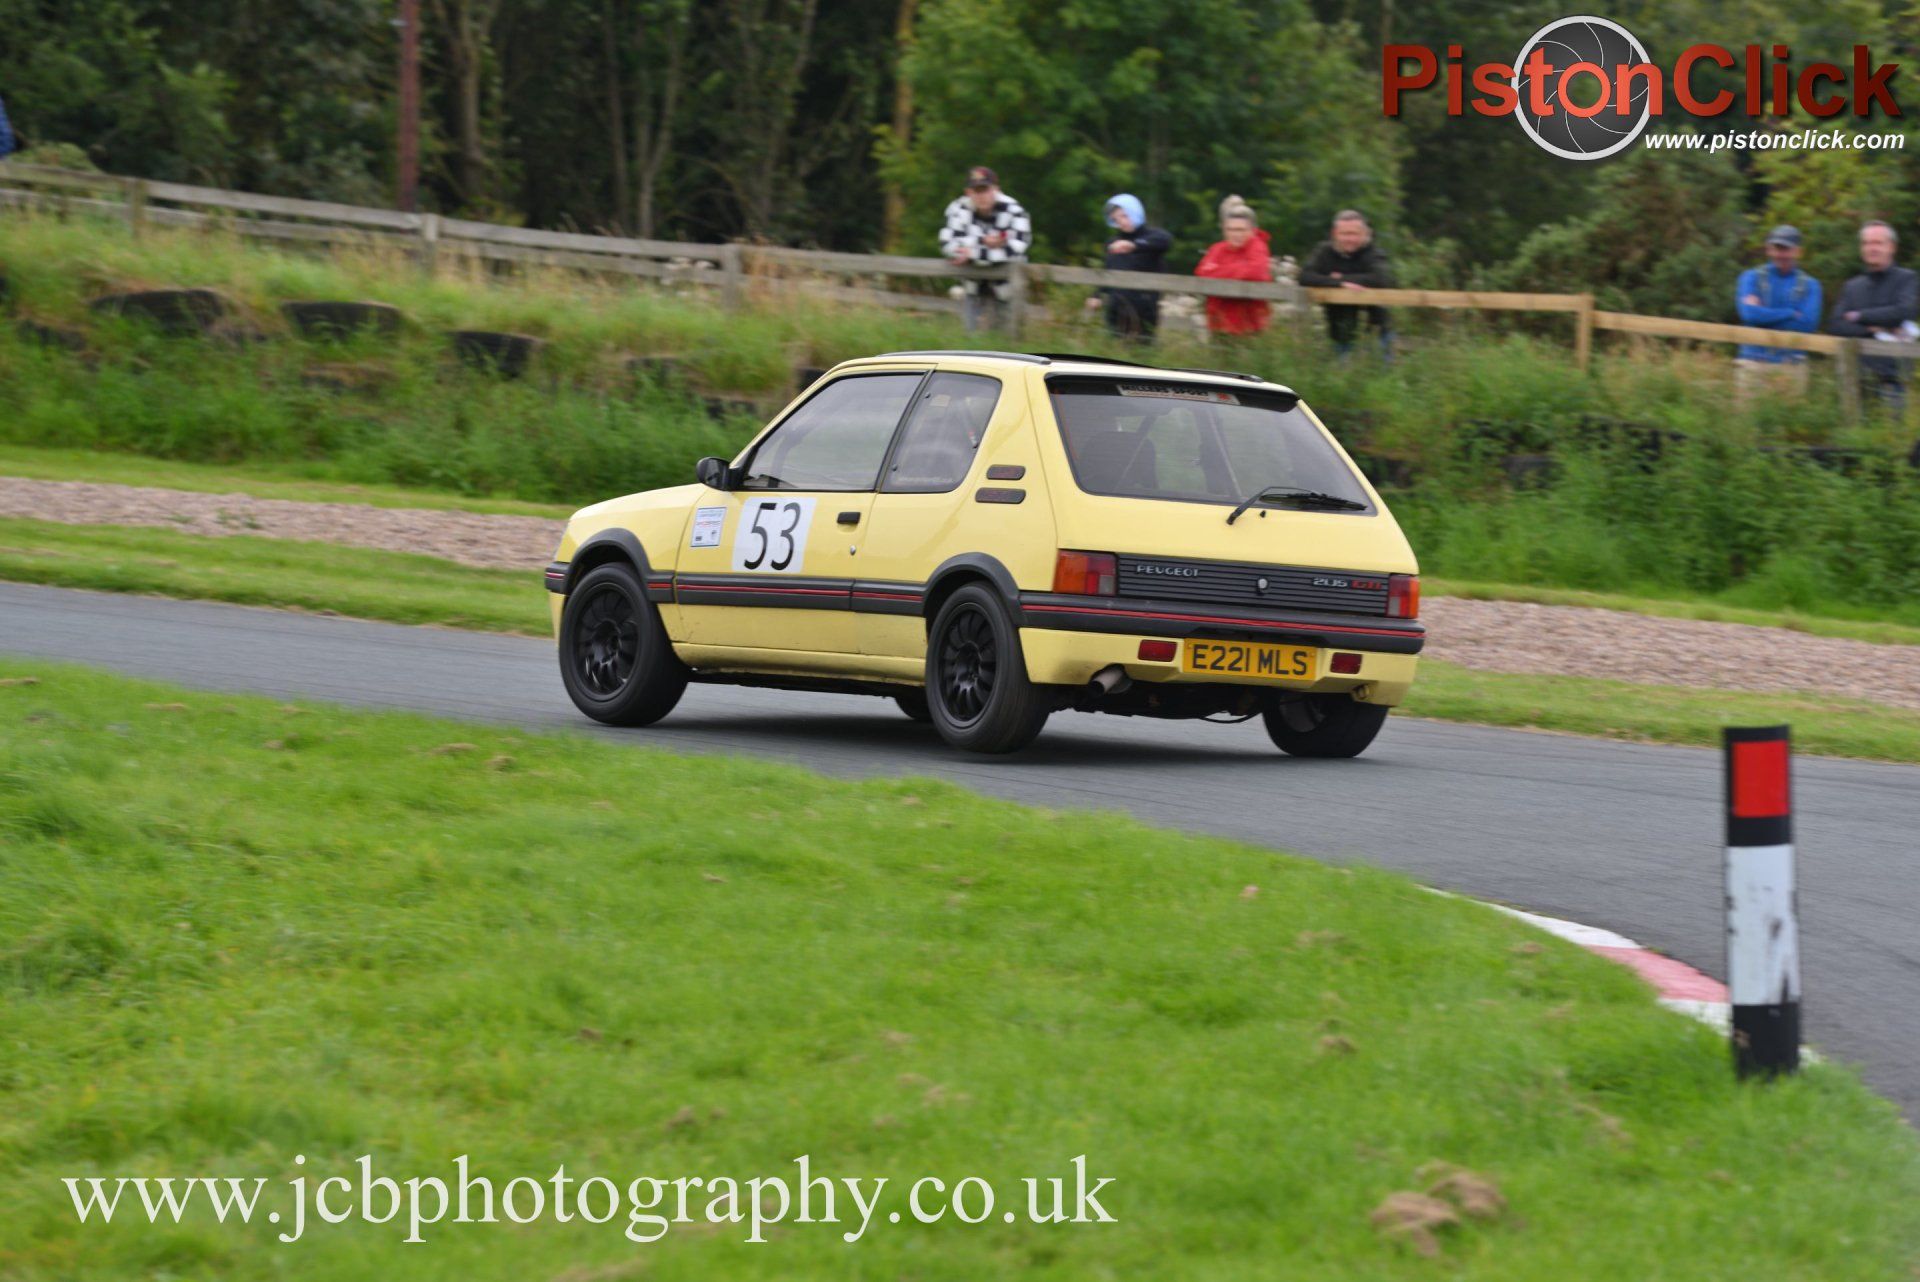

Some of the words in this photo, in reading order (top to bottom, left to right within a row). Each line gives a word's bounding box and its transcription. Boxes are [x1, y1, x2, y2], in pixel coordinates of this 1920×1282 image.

[743, 501, 802, 571] 53
[1136, 565, 1200, 577] PEUGEOT
[1312, 577, 1348, 588] 205
[1192, 643, 1251, 672] E221
[1258, 648, 1308, 676] MLS
